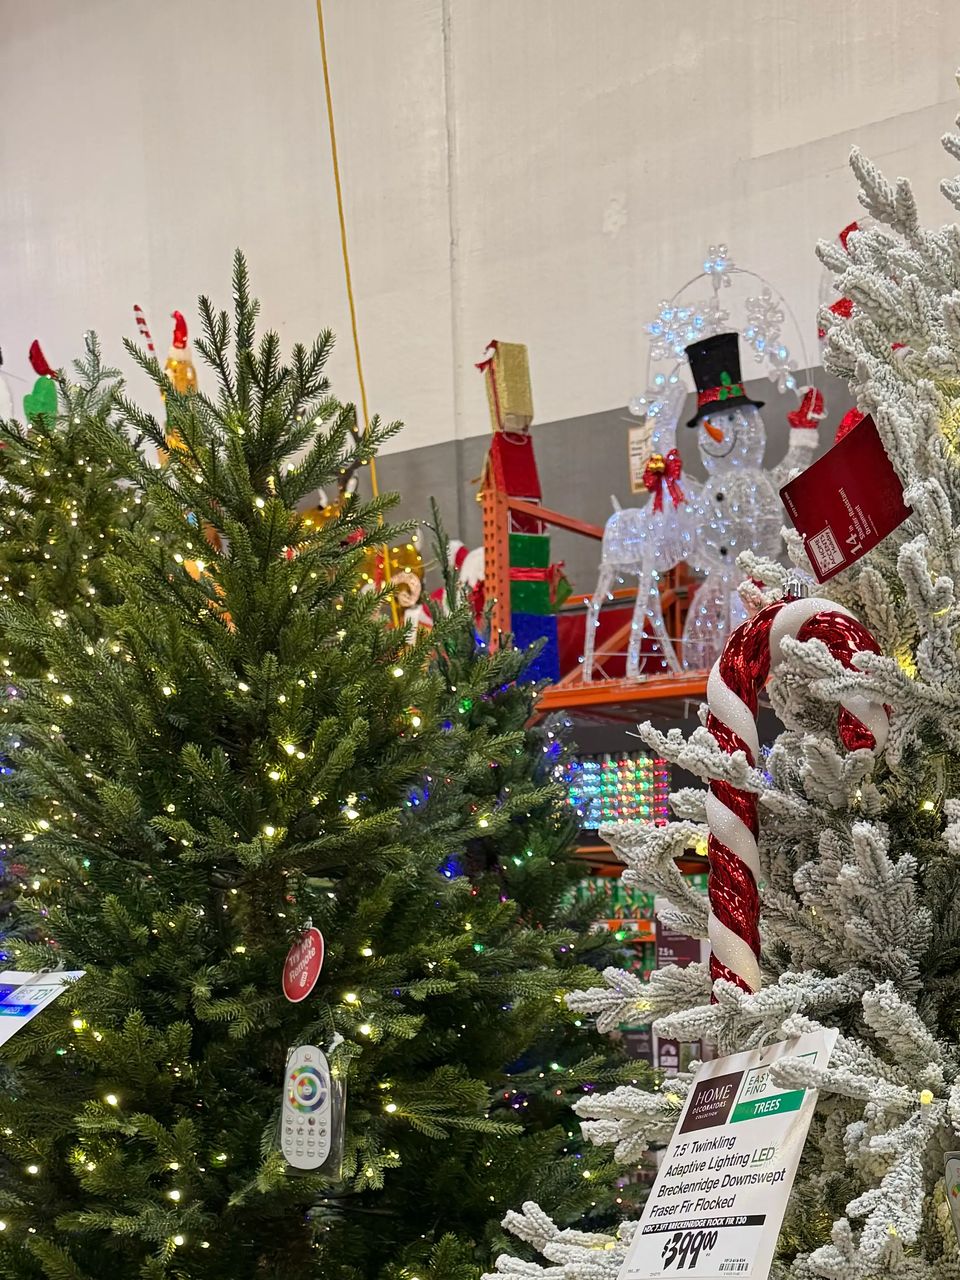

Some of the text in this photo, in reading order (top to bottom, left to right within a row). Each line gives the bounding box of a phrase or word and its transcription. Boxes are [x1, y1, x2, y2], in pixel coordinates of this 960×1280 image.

[838, 487, 866, 540] Shatter-Resistant
[855, 505, 872, 535] Ornament
[814, 538, 826, 559] HOME
[820, 535, 836, 564] ACCENTS
[845, 533, 863, 555] 14
[289, 947, 316, 984] Remote
[749, 1070, 770, 1086] EASY
[695, 1084, 733, 1105] HOME
[745, 1084, 767, 1097] FIND
[692, 1100, 727, 1115] DECORATORS
[753, 1098, 782, 1115] TREES
[672, 1135, 736, 1157] 7.5' Twinkling
[664, 1147, 776, 1178] Adaptive Lighting LED
[657, 1167, 786, 1198] Breckenridge Downswept
[649, 1194, 736, 1218] Fraser Fir Flocked
[668, 1220, 707, 1230] BRECKENRIDGE
[706, 1218, 725, 1226] FLOCK
[725, 1217, 735, 1225] FIR
